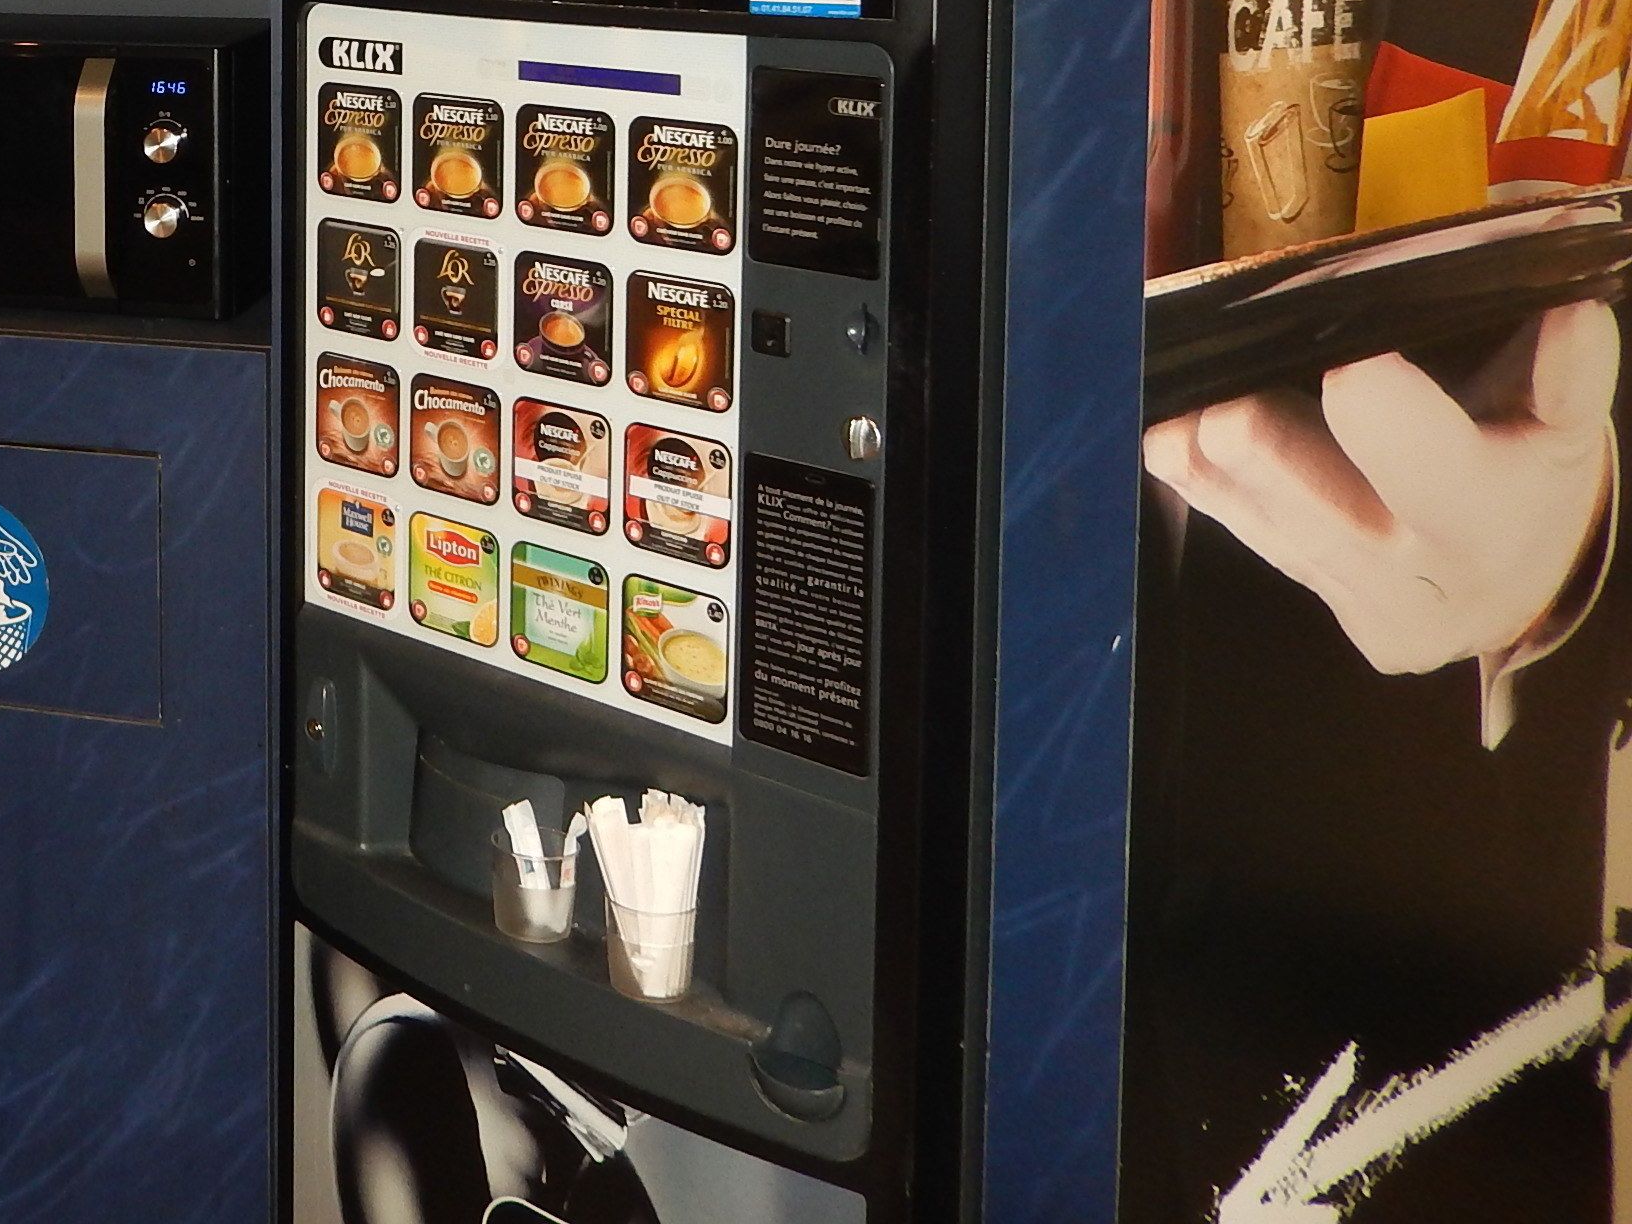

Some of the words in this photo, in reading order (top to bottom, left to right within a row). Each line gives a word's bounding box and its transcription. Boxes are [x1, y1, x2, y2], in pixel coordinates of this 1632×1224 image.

[332, 39, 395, 72] KLIX
[337, 92, 385, 111] NESCAFÉ
[837, 99, 874, 117] KLIX
[324, 99, 385, 131] Espresso
[433, 104, 486, 125] NESCAFÉ
[537, 113, 594, 135] NESCAFÉ
[420, 112, 486, 147] Espresso
[523, 121, 594, 156] Espresso
[653, 125, 716, 149] NESCAFÉ
[637, 133, 716, 171] Espresso
[765, 137, 792, 151] Dure
[523, 267, 594, 302] Espresso
[534, 262, 590, 287] NESCAFÉ
[648, 282, 711, 309] NESCAFÉ
[320, 368, 385, 393] Chocamento
[414, 389, 486, 416] Chocamento
[758, 493, 783, 509] KLIX
[429, 532, 477, 562] Lipton
[443, 571, 482, 592] CITRON
[534, 608, 578, 633] Menthe
